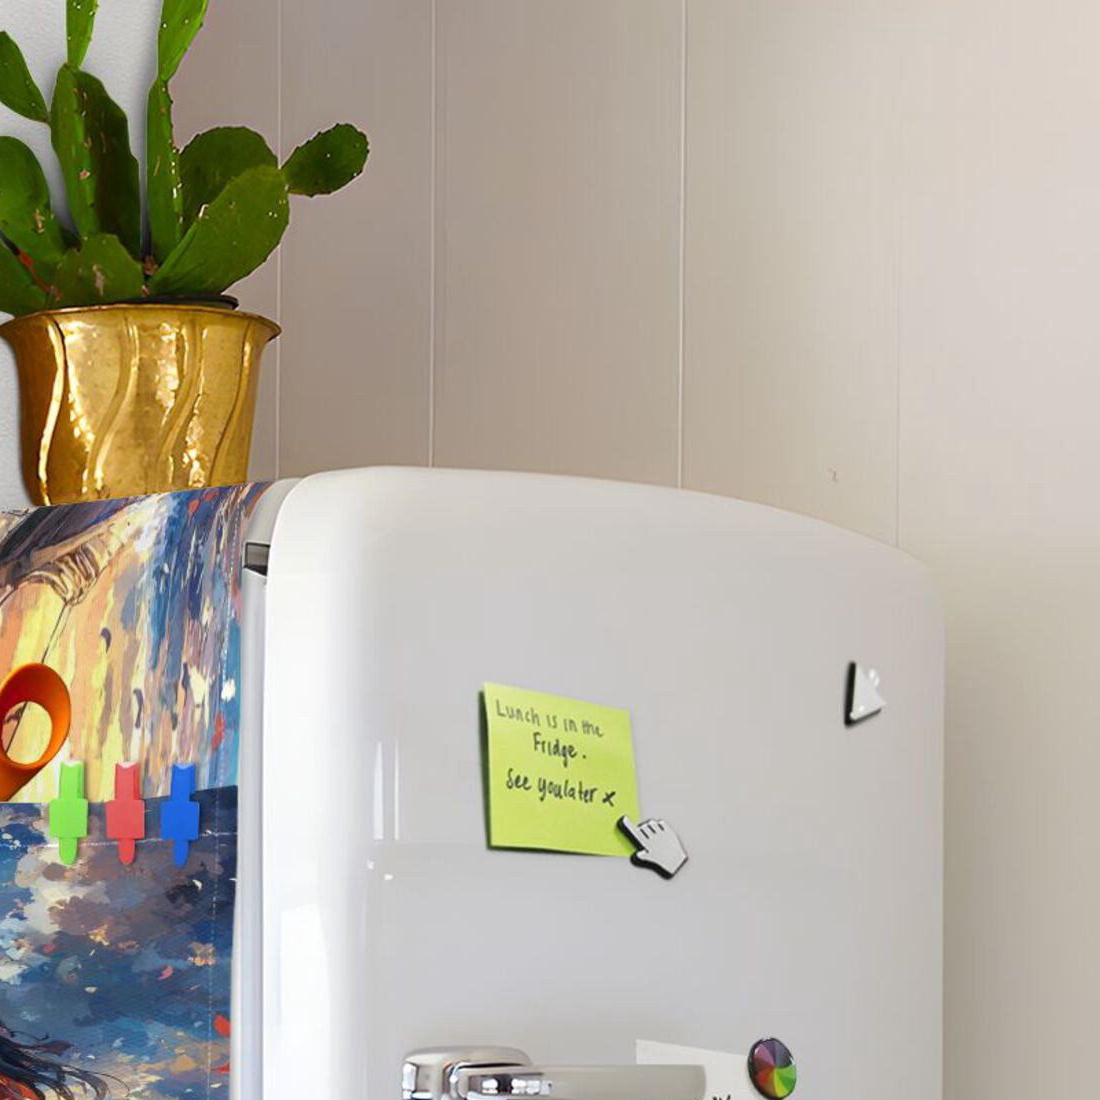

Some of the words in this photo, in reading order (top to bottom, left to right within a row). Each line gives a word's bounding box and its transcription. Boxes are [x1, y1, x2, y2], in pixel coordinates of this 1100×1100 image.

[495, 699, 541, 727] Lunch
[582, 720, 604, 738] the
[506, 767, 532, 791] See
